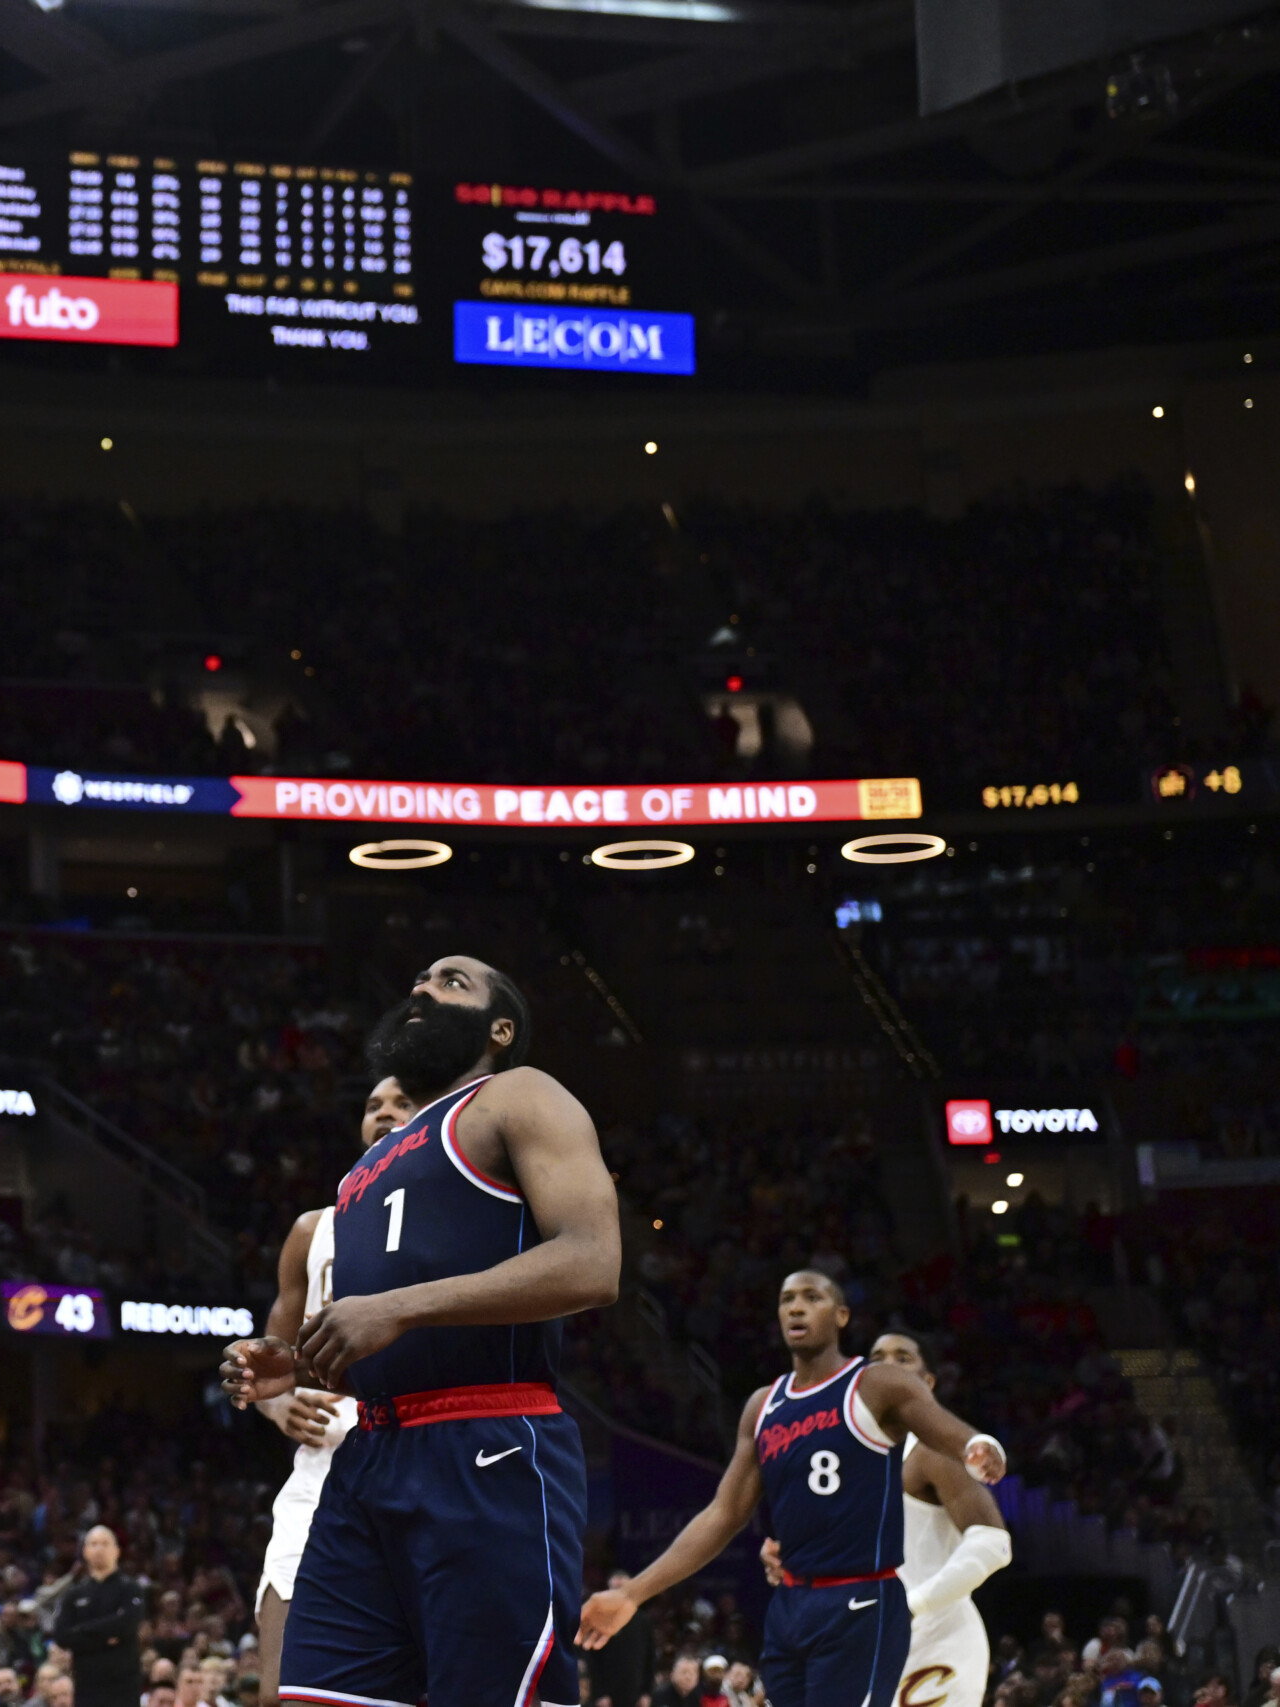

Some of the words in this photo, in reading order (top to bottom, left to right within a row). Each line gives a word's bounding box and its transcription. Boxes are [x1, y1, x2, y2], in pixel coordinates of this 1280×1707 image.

[481, 232, 627, 277] $17,614
[5, 284, 100, 330] fubo
[485, 315, 664, 360] LECOM
[275, 781, 483, 821] PROVIDING
[493, 789, 629, 823] PEACE
[640, 788, 694, 821] OF
[707, 785, 818, 820] MIND
[994, 1108, 1099, 1134] TOYOTA
[383, 1187, 406, 1252] 1
[54, 1294, 96, 1333] 43
[120, 1300, 254, 1337] REBOUNDS
[807, 1449, 841, 1496] 8
